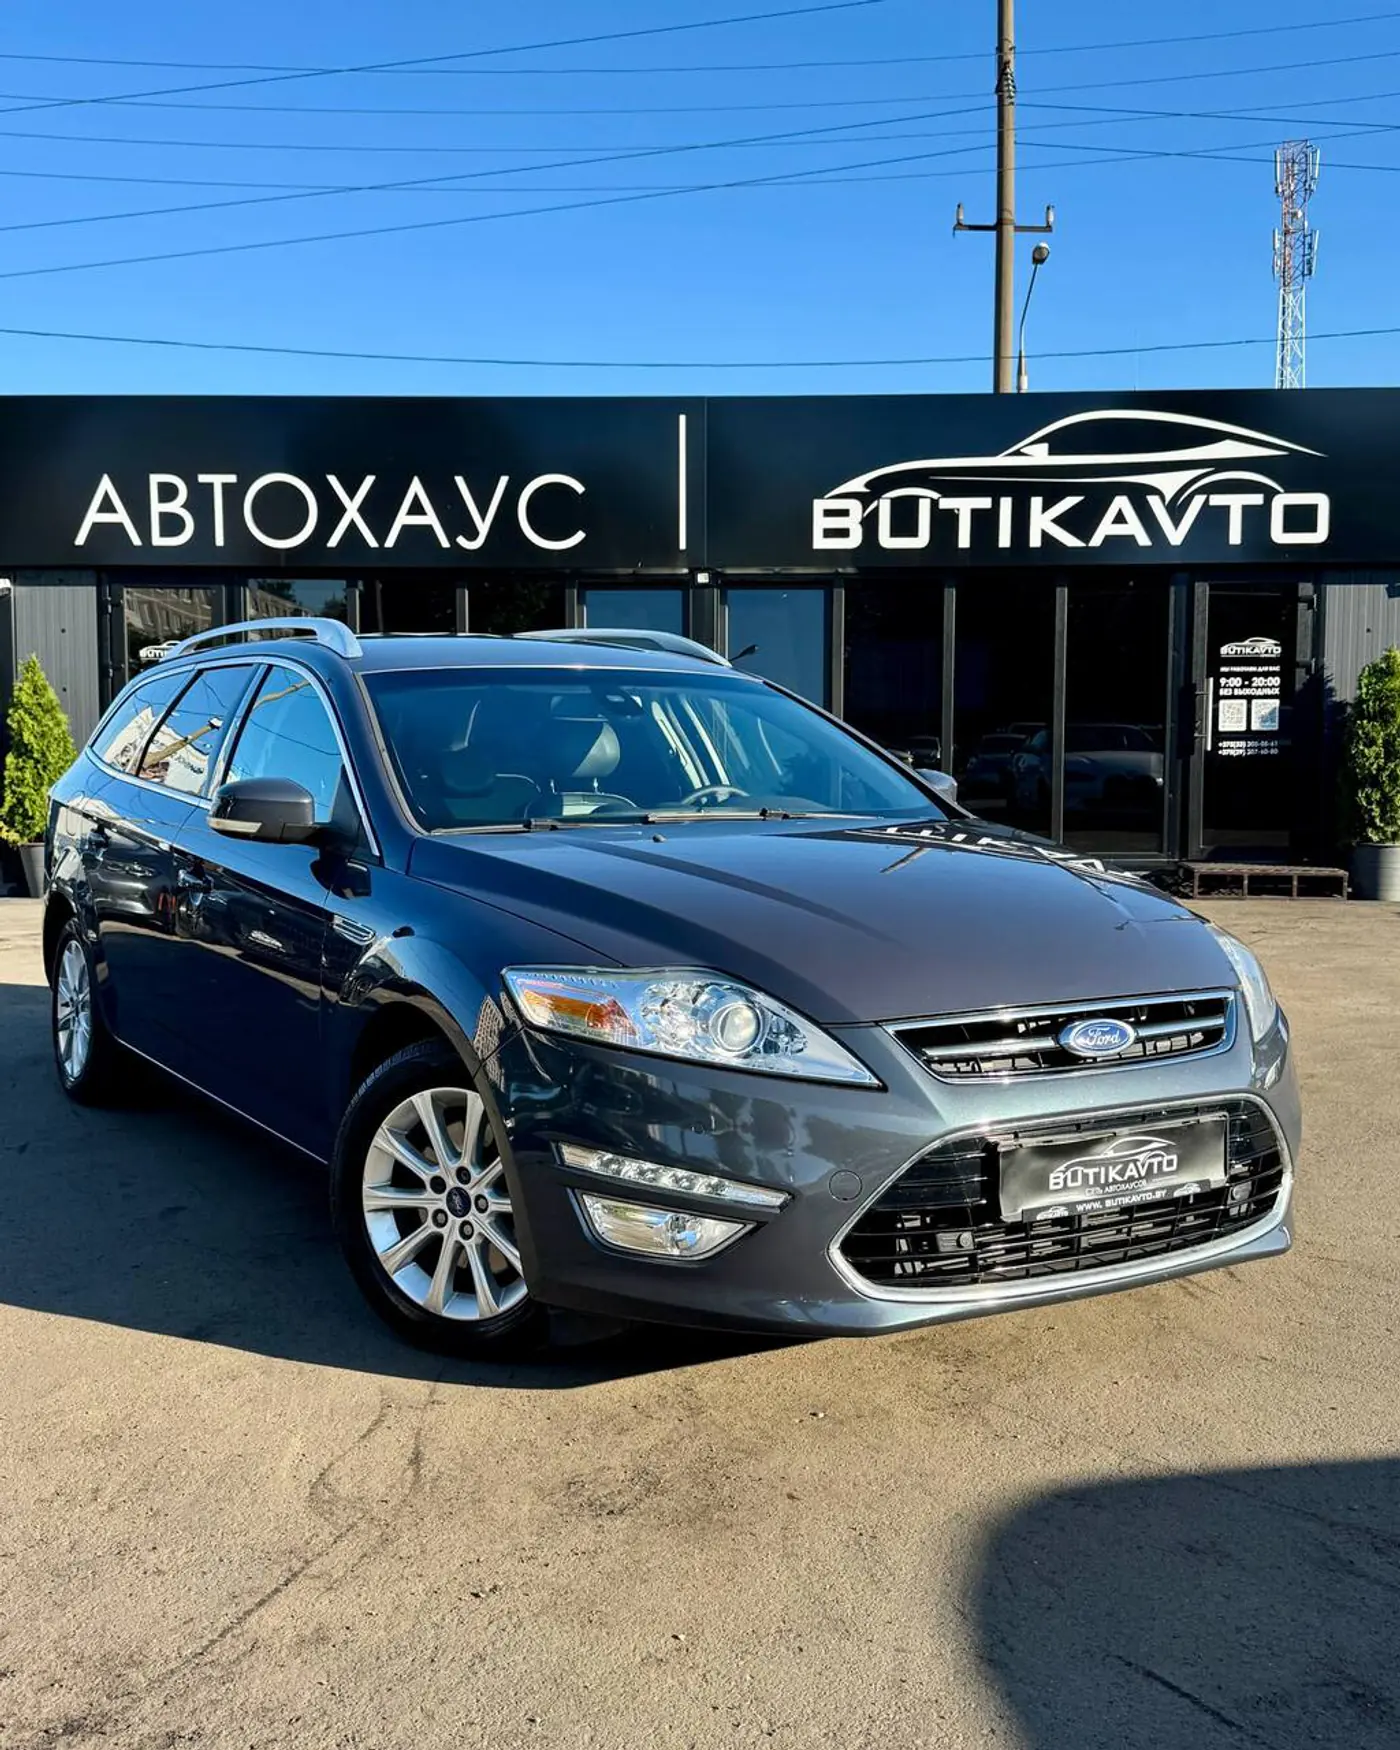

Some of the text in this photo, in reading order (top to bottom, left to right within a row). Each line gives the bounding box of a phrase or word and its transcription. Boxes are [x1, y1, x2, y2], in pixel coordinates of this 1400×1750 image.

[74, 472, 587, 551] АВТОХАУС
[812, 492, 1331, 550] BUTIKAVTO
[1220, 645, 1281, 655] BUTIKAVTO
[1219, 676, 1242, 687] 9:00
[1251, 676, 1281, 687] 20:00
[1219, 687, 1280, 696] БЕЗ ВЫХОДНЫХ
[1084, 1026, 1121, 1046] Ford
[1049, 1154, 1178, 1191] BUTIKAVTO
[1075, 1190, 1167, 1212] WWW. BUTIKAVTO.BY
